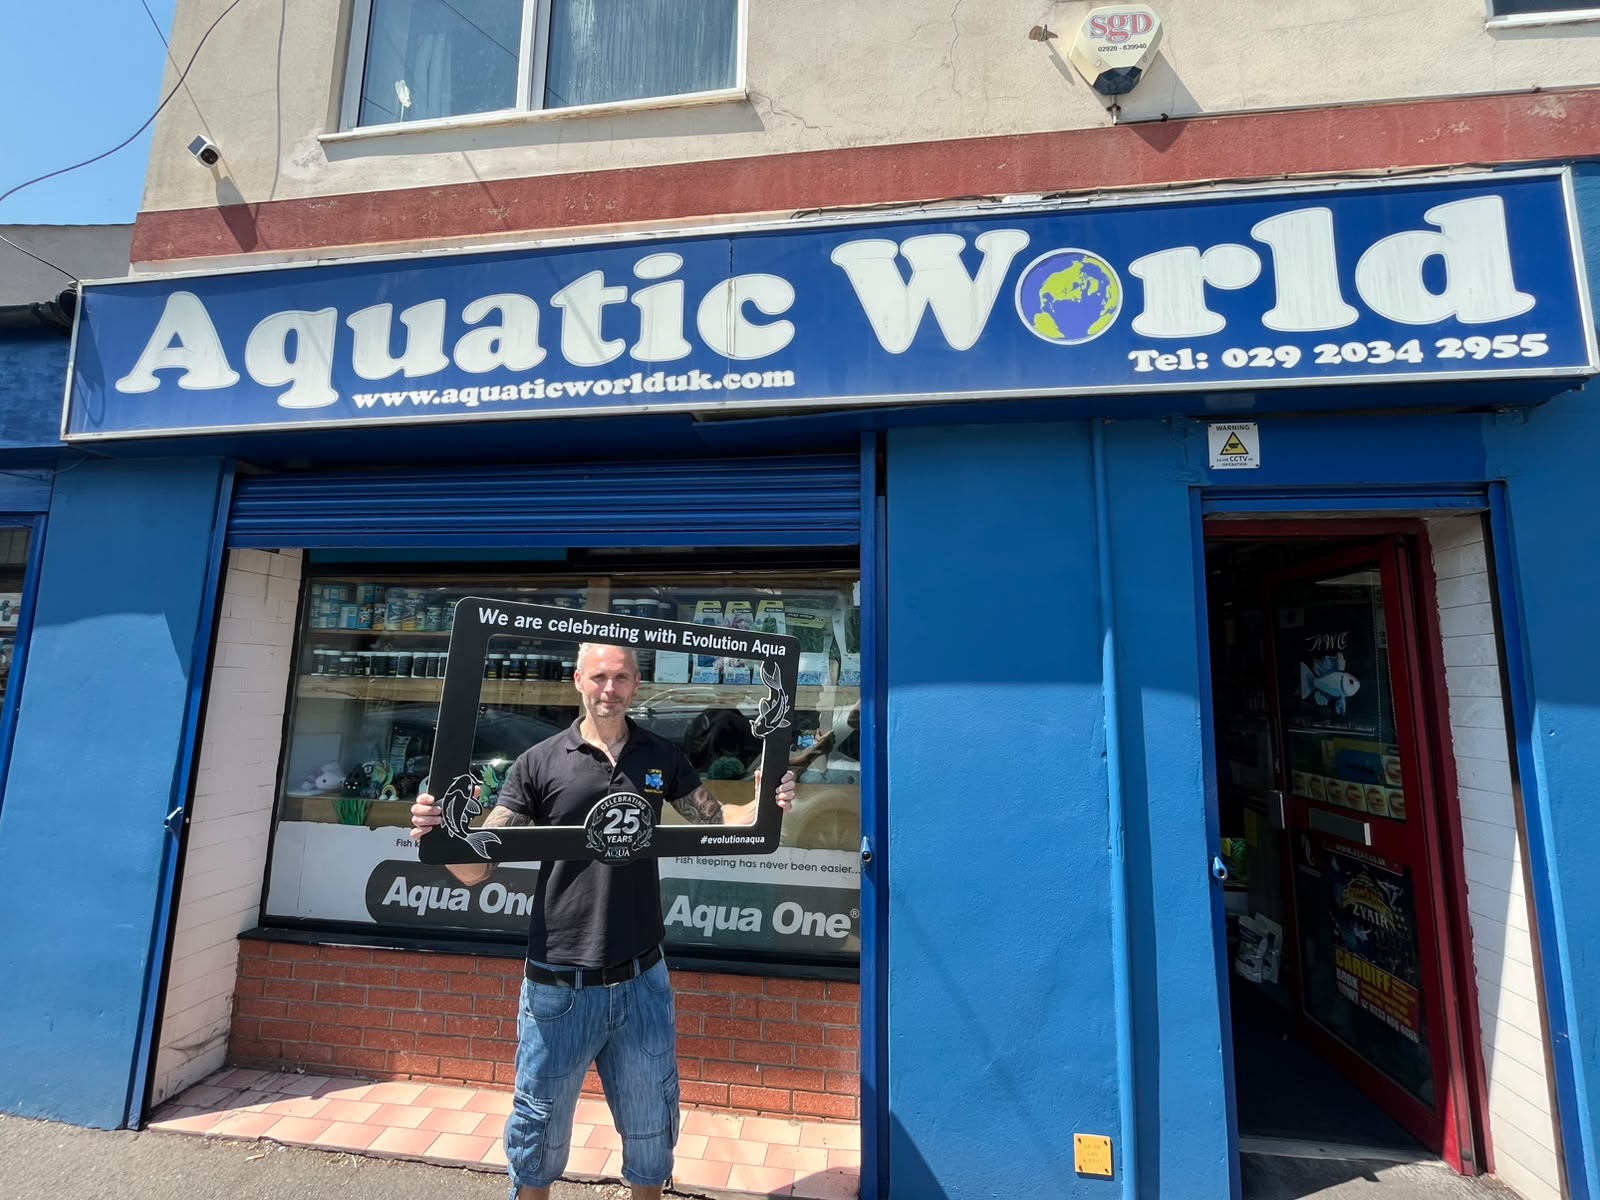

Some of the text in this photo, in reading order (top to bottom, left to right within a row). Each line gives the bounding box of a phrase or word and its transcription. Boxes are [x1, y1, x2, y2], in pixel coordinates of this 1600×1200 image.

[1123, 43, 1147, 51] 839940
[115, 195, 1537, 410] Aquatic World
[1127, 333, 1550, 373] Tel: 029 2034 2955
[352, 369, 796, 409] www.aquaticworlduk.com
[478, 606, 787, 657] We are celebrating with Evolution Aqua
[600, 795, 646, 810] CELEBRATING
[603, 808, 641, 834] 25
[396, 838, 412, 848] Fish
[606, 835, 633, 843] YEARS
[700, 835, 765, 845] #evolutionaqua
[604, 849, 630, 858] AQUA
[675, 854, 693, 864] Fish
[696, 855, 736, 869] keeping
[739, 859, 757, 869] has
[760, 861, 788, 870] never
[790, 861, 818, 872] been
[381, 876, 471, 916] Aqua
[663, 894, 763, 937] Aqua
[1335, 947, 1391, 993] CARDIFF
